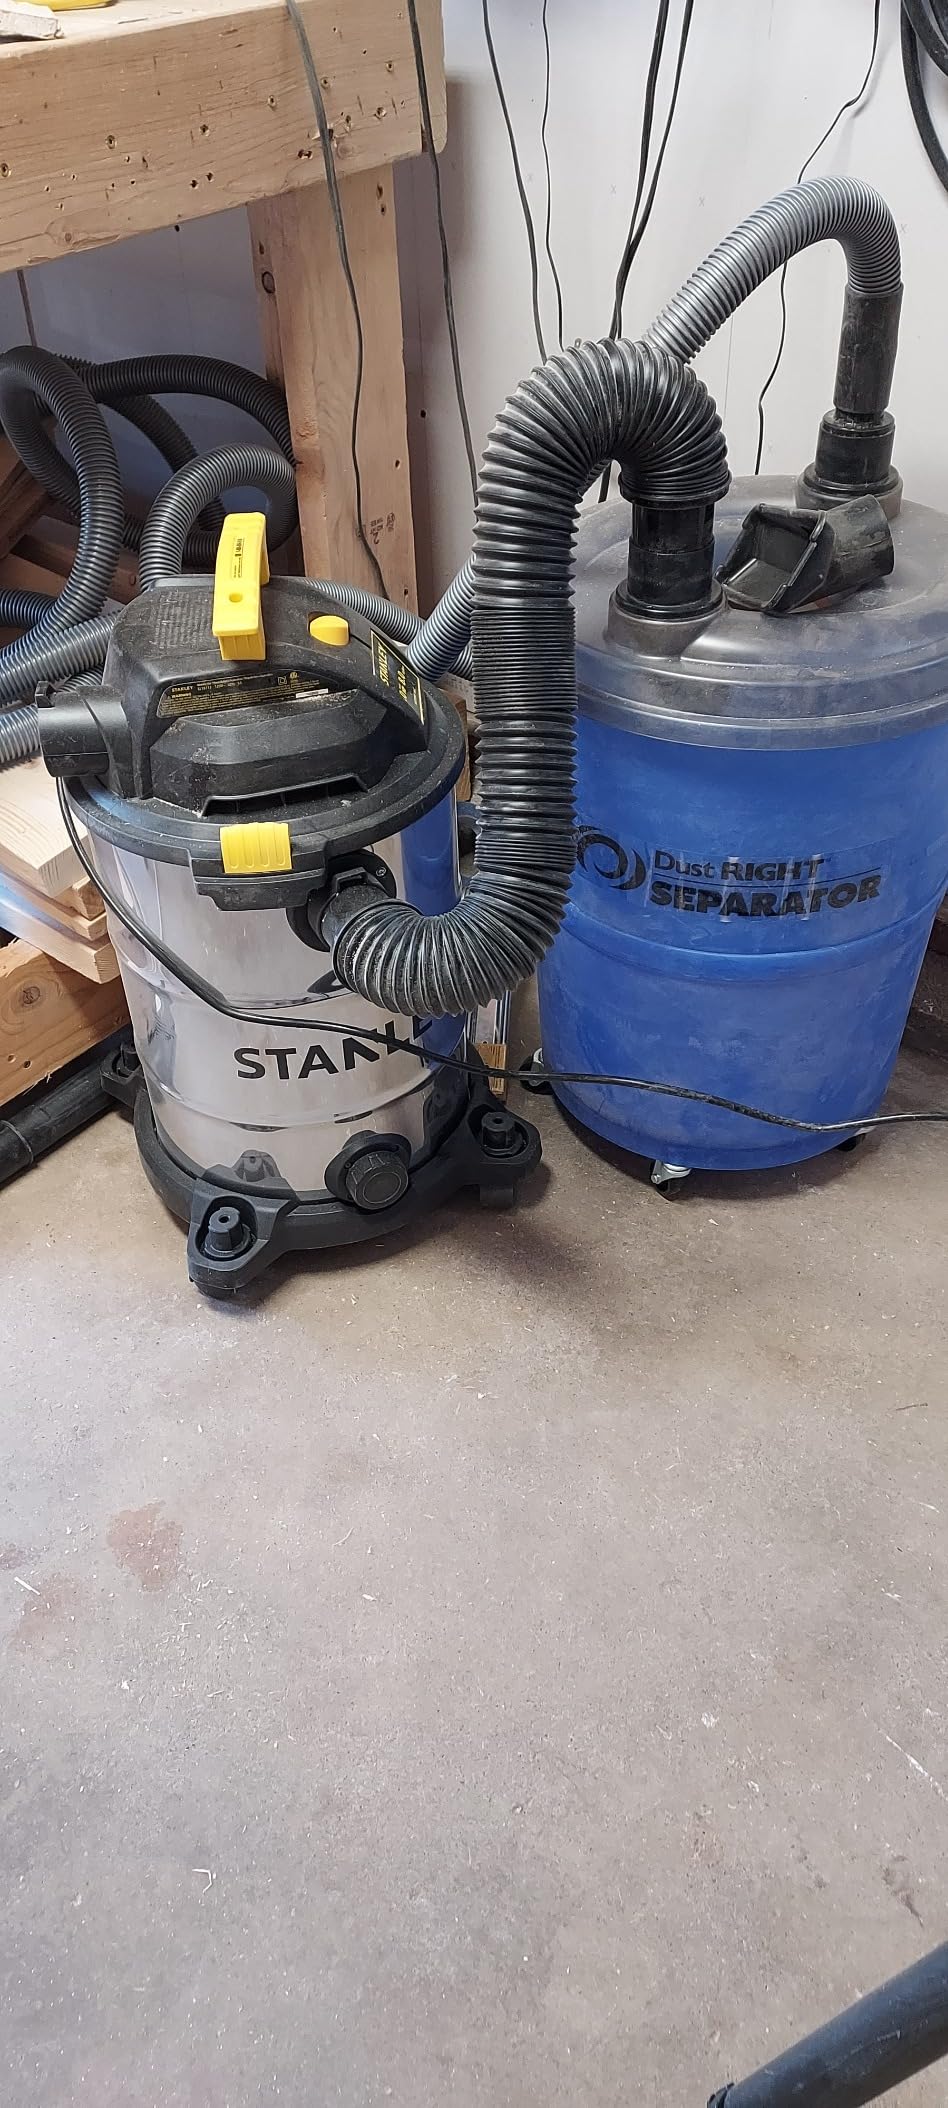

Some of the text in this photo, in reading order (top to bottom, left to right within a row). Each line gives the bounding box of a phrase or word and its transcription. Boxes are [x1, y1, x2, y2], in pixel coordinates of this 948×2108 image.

[378, 640, 390, 687] STANLEY
[171, 685, 194, 693] STANLEY
[654, 850, 826, 881] Dust RIGHT
[649, 874, 883, 917] SEPARATOR
[234, 1014, 433, 1080] STANLE
